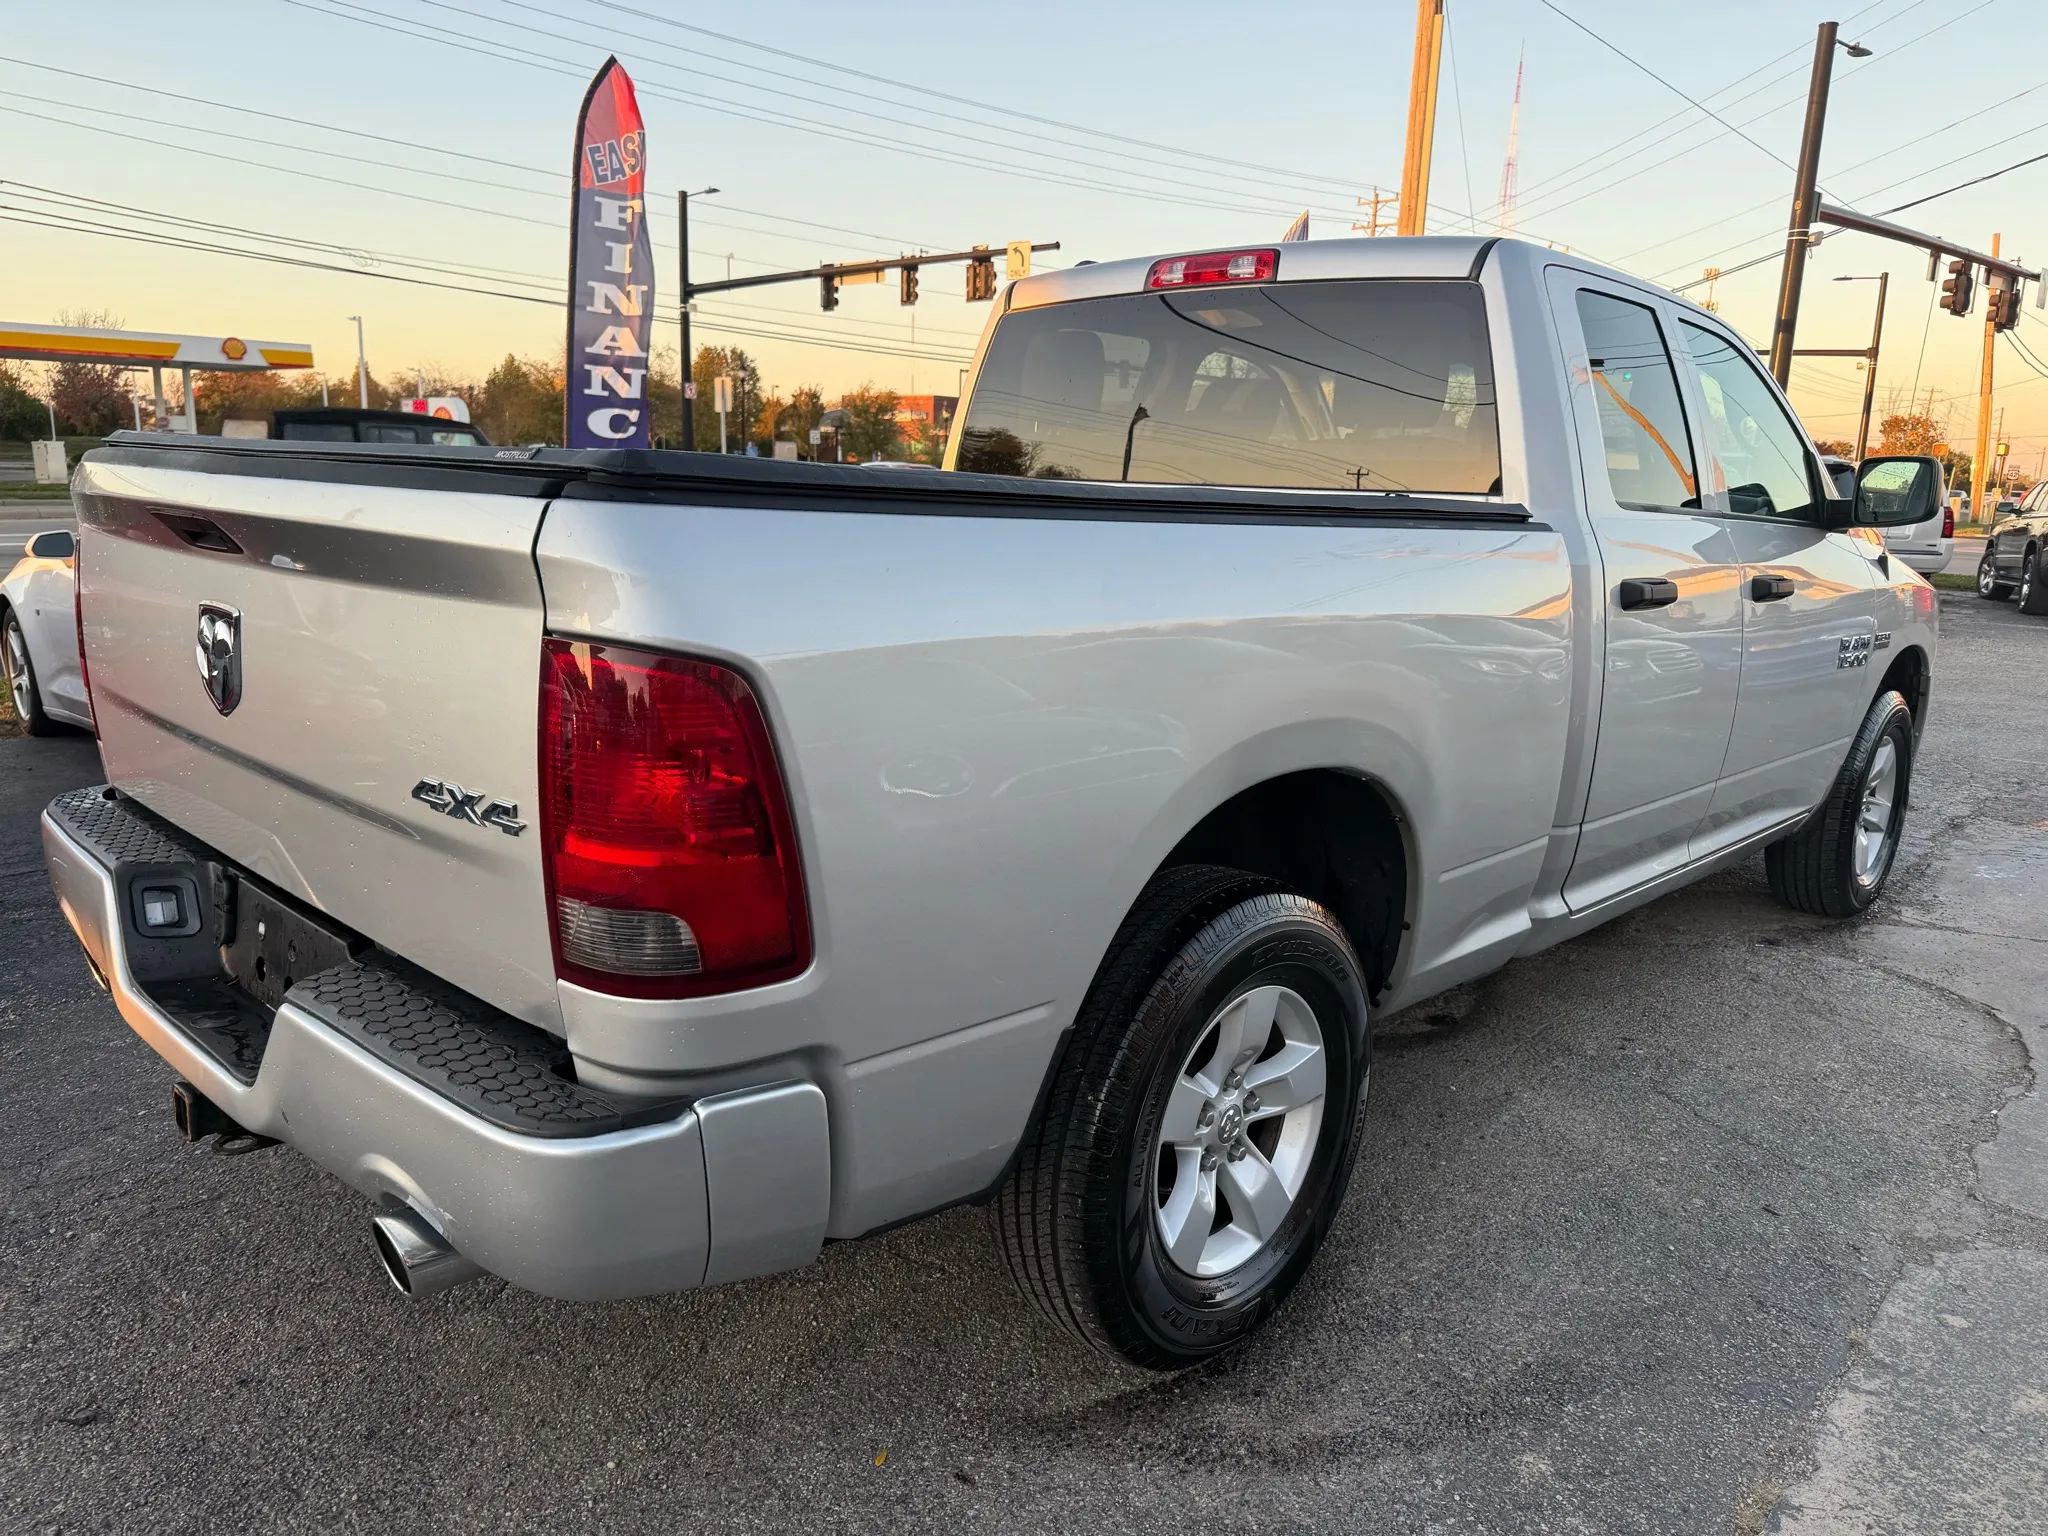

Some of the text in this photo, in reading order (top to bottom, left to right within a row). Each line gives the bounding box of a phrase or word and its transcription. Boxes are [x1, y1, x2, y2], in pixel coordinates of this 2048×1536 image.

[583, 196, 649, 449] FINANC
[1839, 635, 1871, 652] RAM
[1837, 652, 1868, 669] 1500
